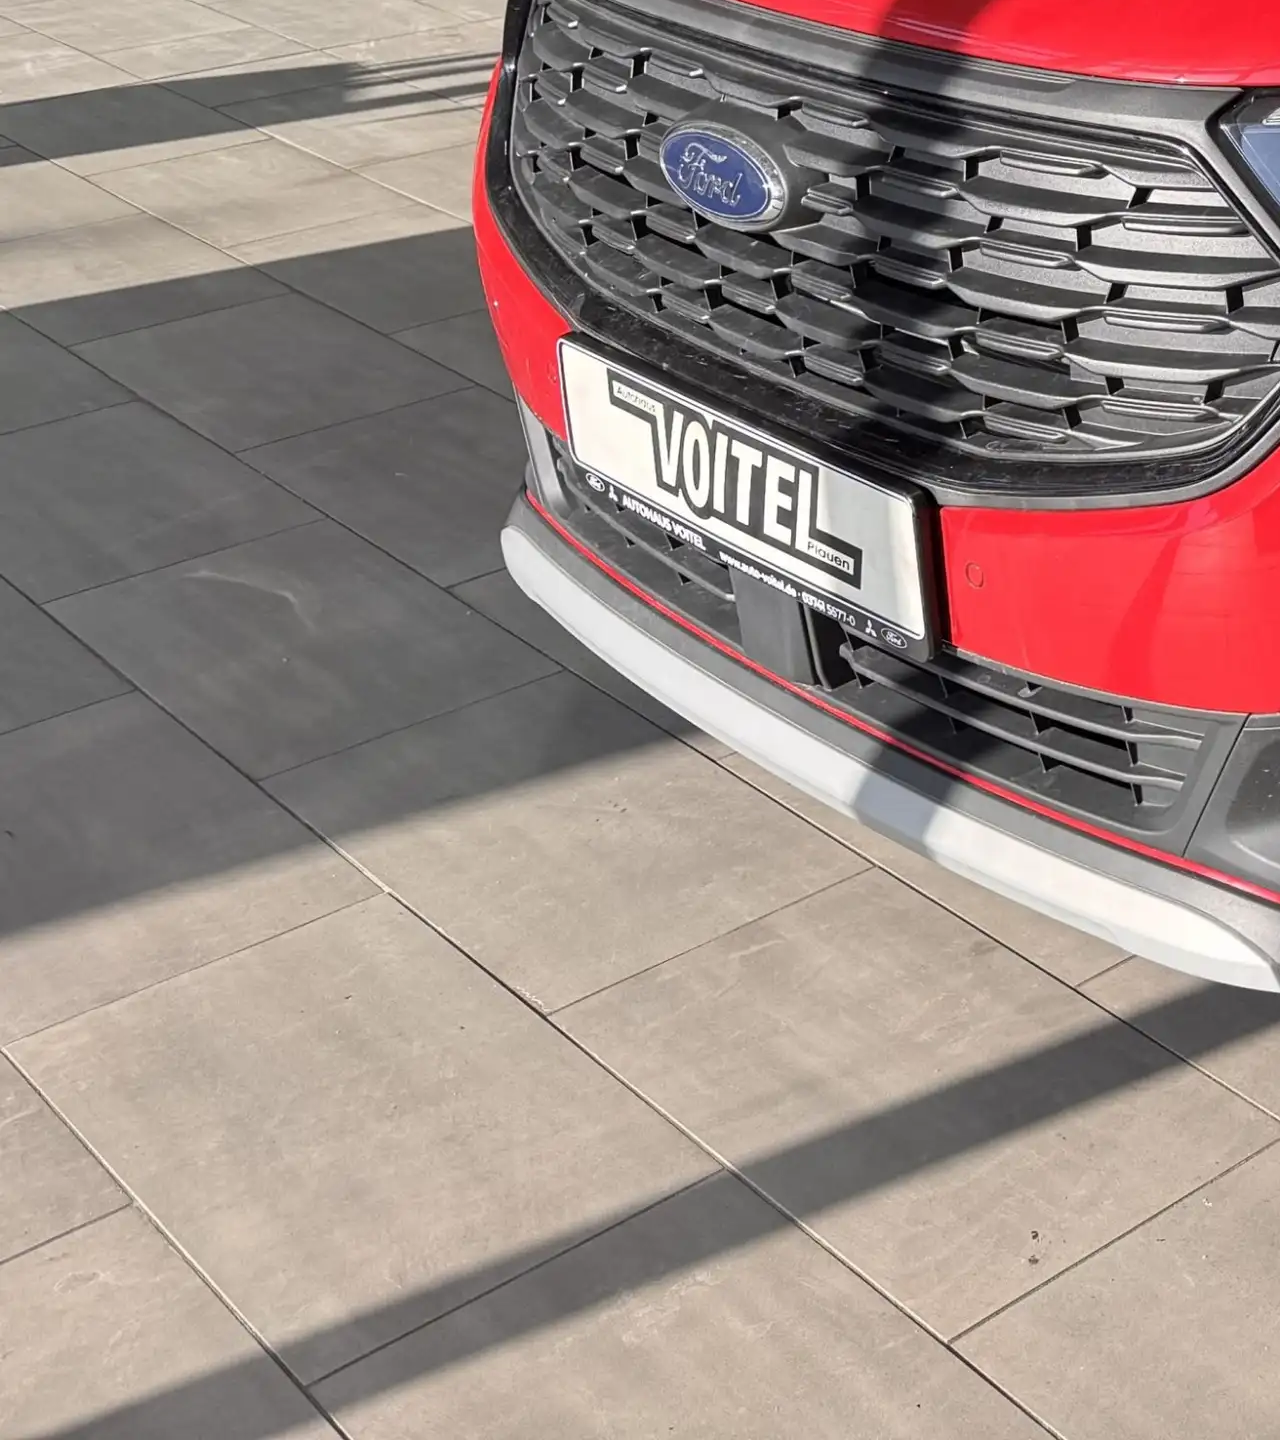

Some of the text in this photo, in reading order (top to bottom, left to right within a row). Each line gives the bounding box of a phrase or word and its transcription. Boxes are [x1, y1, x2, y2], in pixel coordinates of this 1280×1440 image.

[677, 142, 744, 207] Ford
[654, 405, 814, 552] VOITEL
[622, 494, 672, 531] AUTOHAUS
[670, 520, 706, 551] VOITEL
[807, 541, 850, 571] Plauen
